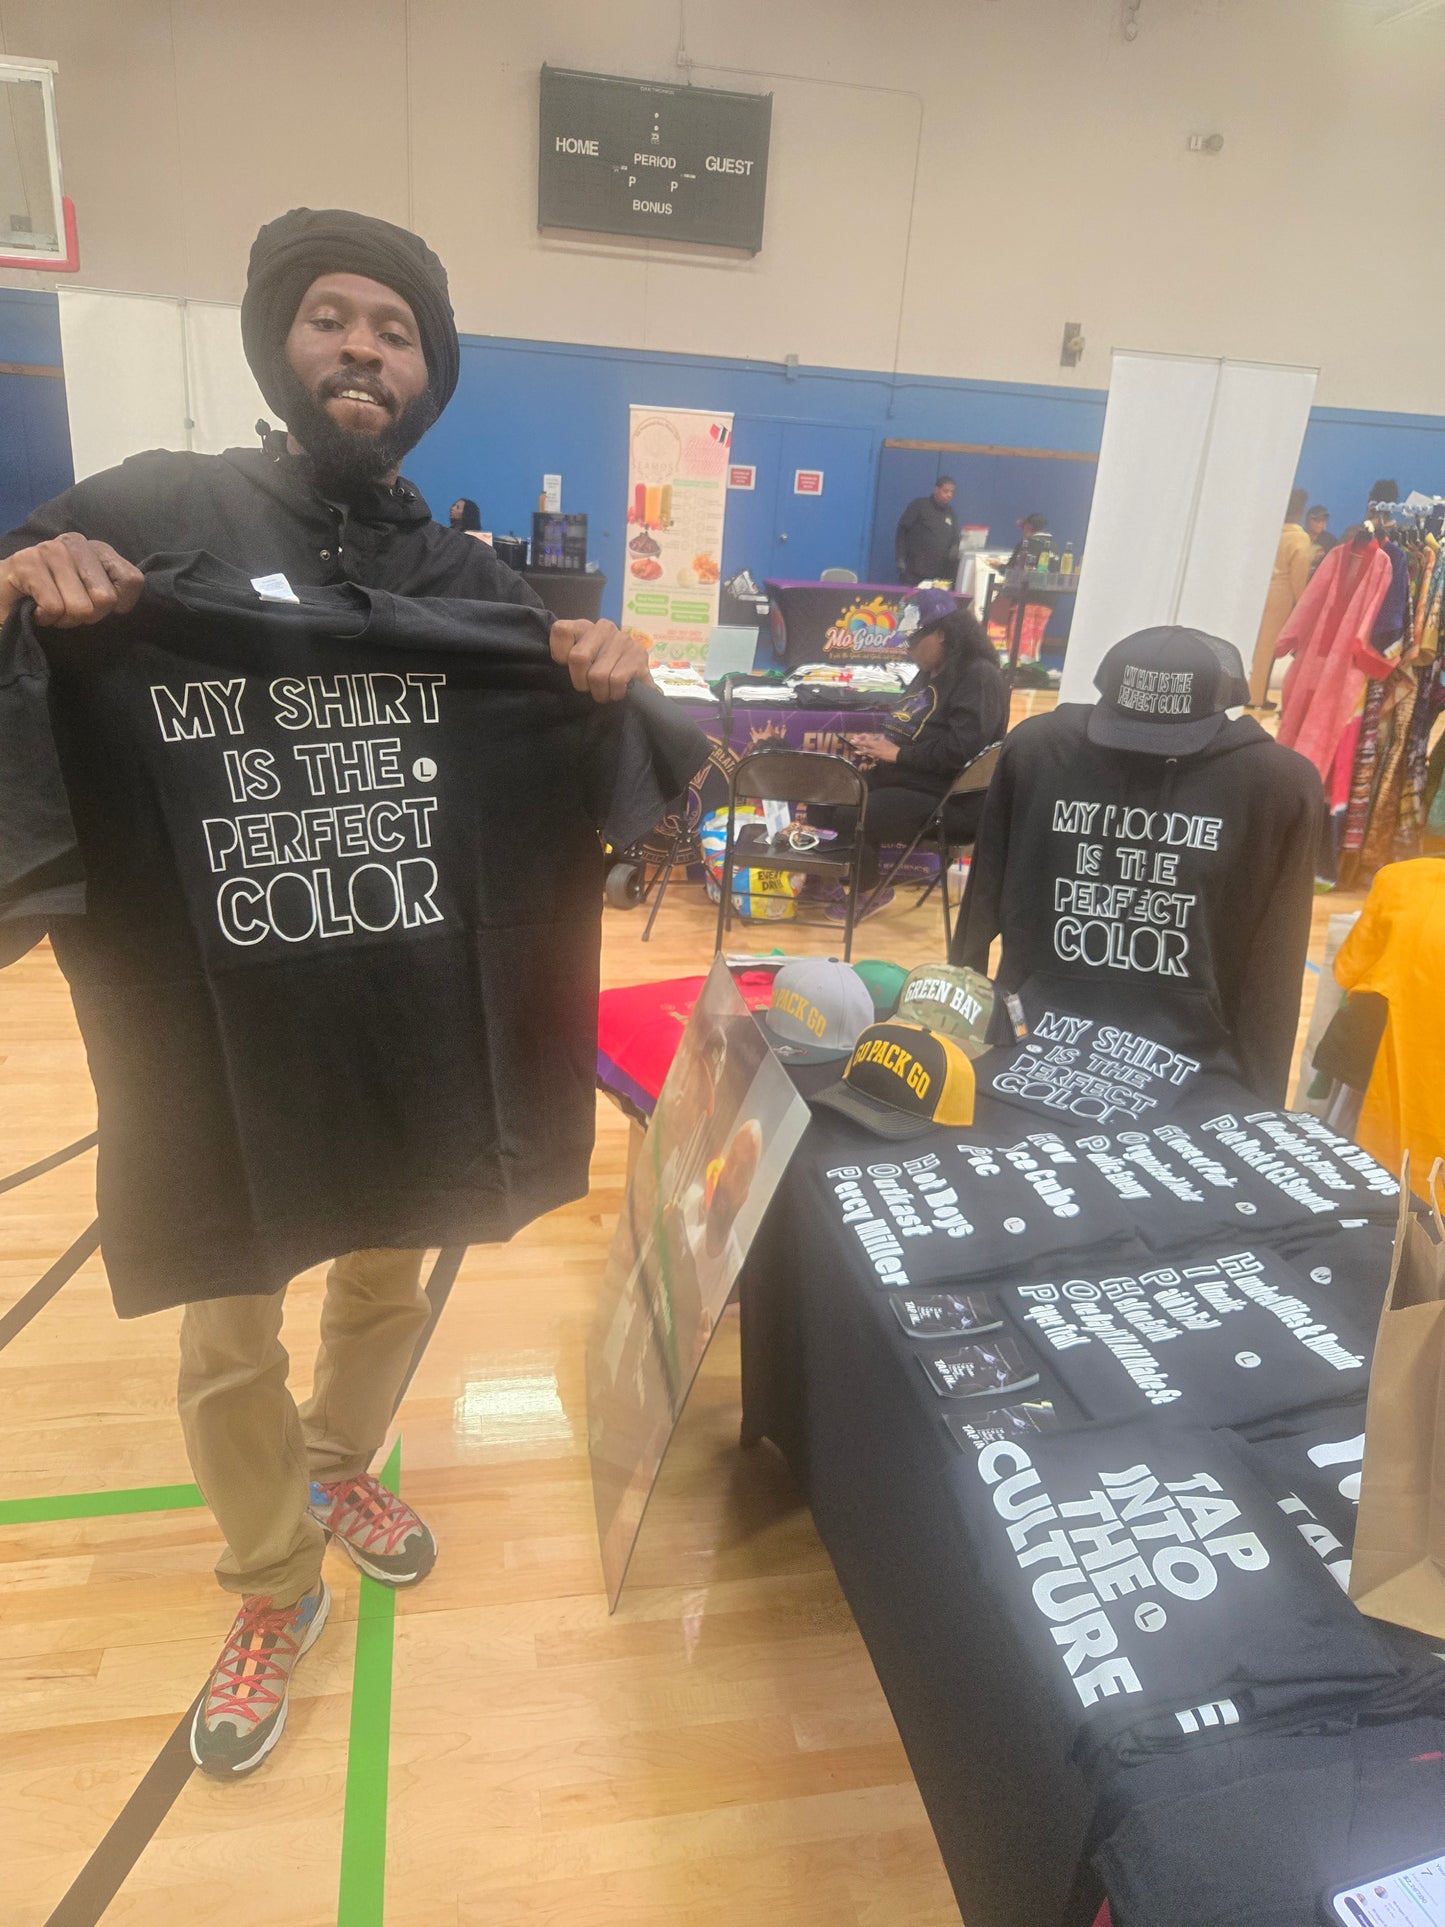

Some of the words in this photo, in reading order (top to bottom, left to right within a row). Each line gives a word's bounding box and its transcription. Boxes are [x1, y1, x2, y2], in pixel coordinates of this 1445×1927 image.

[555, 137, 600, 156] HOME
[634, 153, 677, 170] PERIOD
[705, 156, 754, 176] GUEST
[628, 176, 637, 188] P
[670, 181, 679, 193] P
[632, 200, 673, 215] BONUS
[1117, 685, 1158, 713] PERFECT
[1157, 694, 1192, 714] COLOR
[1157, 672, 1171, 692] IS
[1170, 672, 1194, 693] THE
[150, 678, 246, 742] MY
[269, 673, 446, 730] SHIRT
[223, 749, 281, 803] IS
[294, 737, 405, 796] THE
[202, 797, 438, 872] PERFECT
[1053, 800, 1100, 834] MY
[1076, 843, 1103, 876] IS
[1116, 847, 1179, 886] THE
[217, 857, 444, 945] COLOR
[1055, 878, 1195, 928] PERFECT
[1054, 916, 1190, 977] COLOR
[777, 988, 809, 1022] PACK
[807, 1006, 828, 1039] GO
[904, 979, 952, 1004] GREEN
[950, 987, 983, 1025] BAY
[852, 1040, 872, 1067] GO
[866, 1040, 913, 1078] PACK
[906, 1062, 931, 1100] GO
[1034, 1012, 1093, 1045] MY
[1092, 1026, 1200, 1086] SHIRT
[1045, 1046, 1081, 1065] IS
[1087, 1053, 1152, 1089] THE
[1010, 1054, 1158, 1114] PERFECT
[957, 1144, 1001, 1177] Pac
[1026, 1133, 1078, 1164] Hov
[903, 1153, 948, 1193] Hot
[1024, 1169, 1081, 1218] Cube
[867, 1163, 933, 1237] Outkast
[924, 1187, 974, 1238] Boys
[826, 1166, 875, 1224] Percy
[854, 1218, 910, 1287] Miller
[1137, 1267, 1196, 1310] Paid
[934, 1359, 950, 1375] TAP
[962, 1424, 980, 1441] TAP
[1098, 1464, 1219, 1601] INTO
[1164, 1472, 1271, 1571] TAP
[1058, 1490, 1156, 1602] THE
[977, 1440, 1143, 1708] CULTURE
